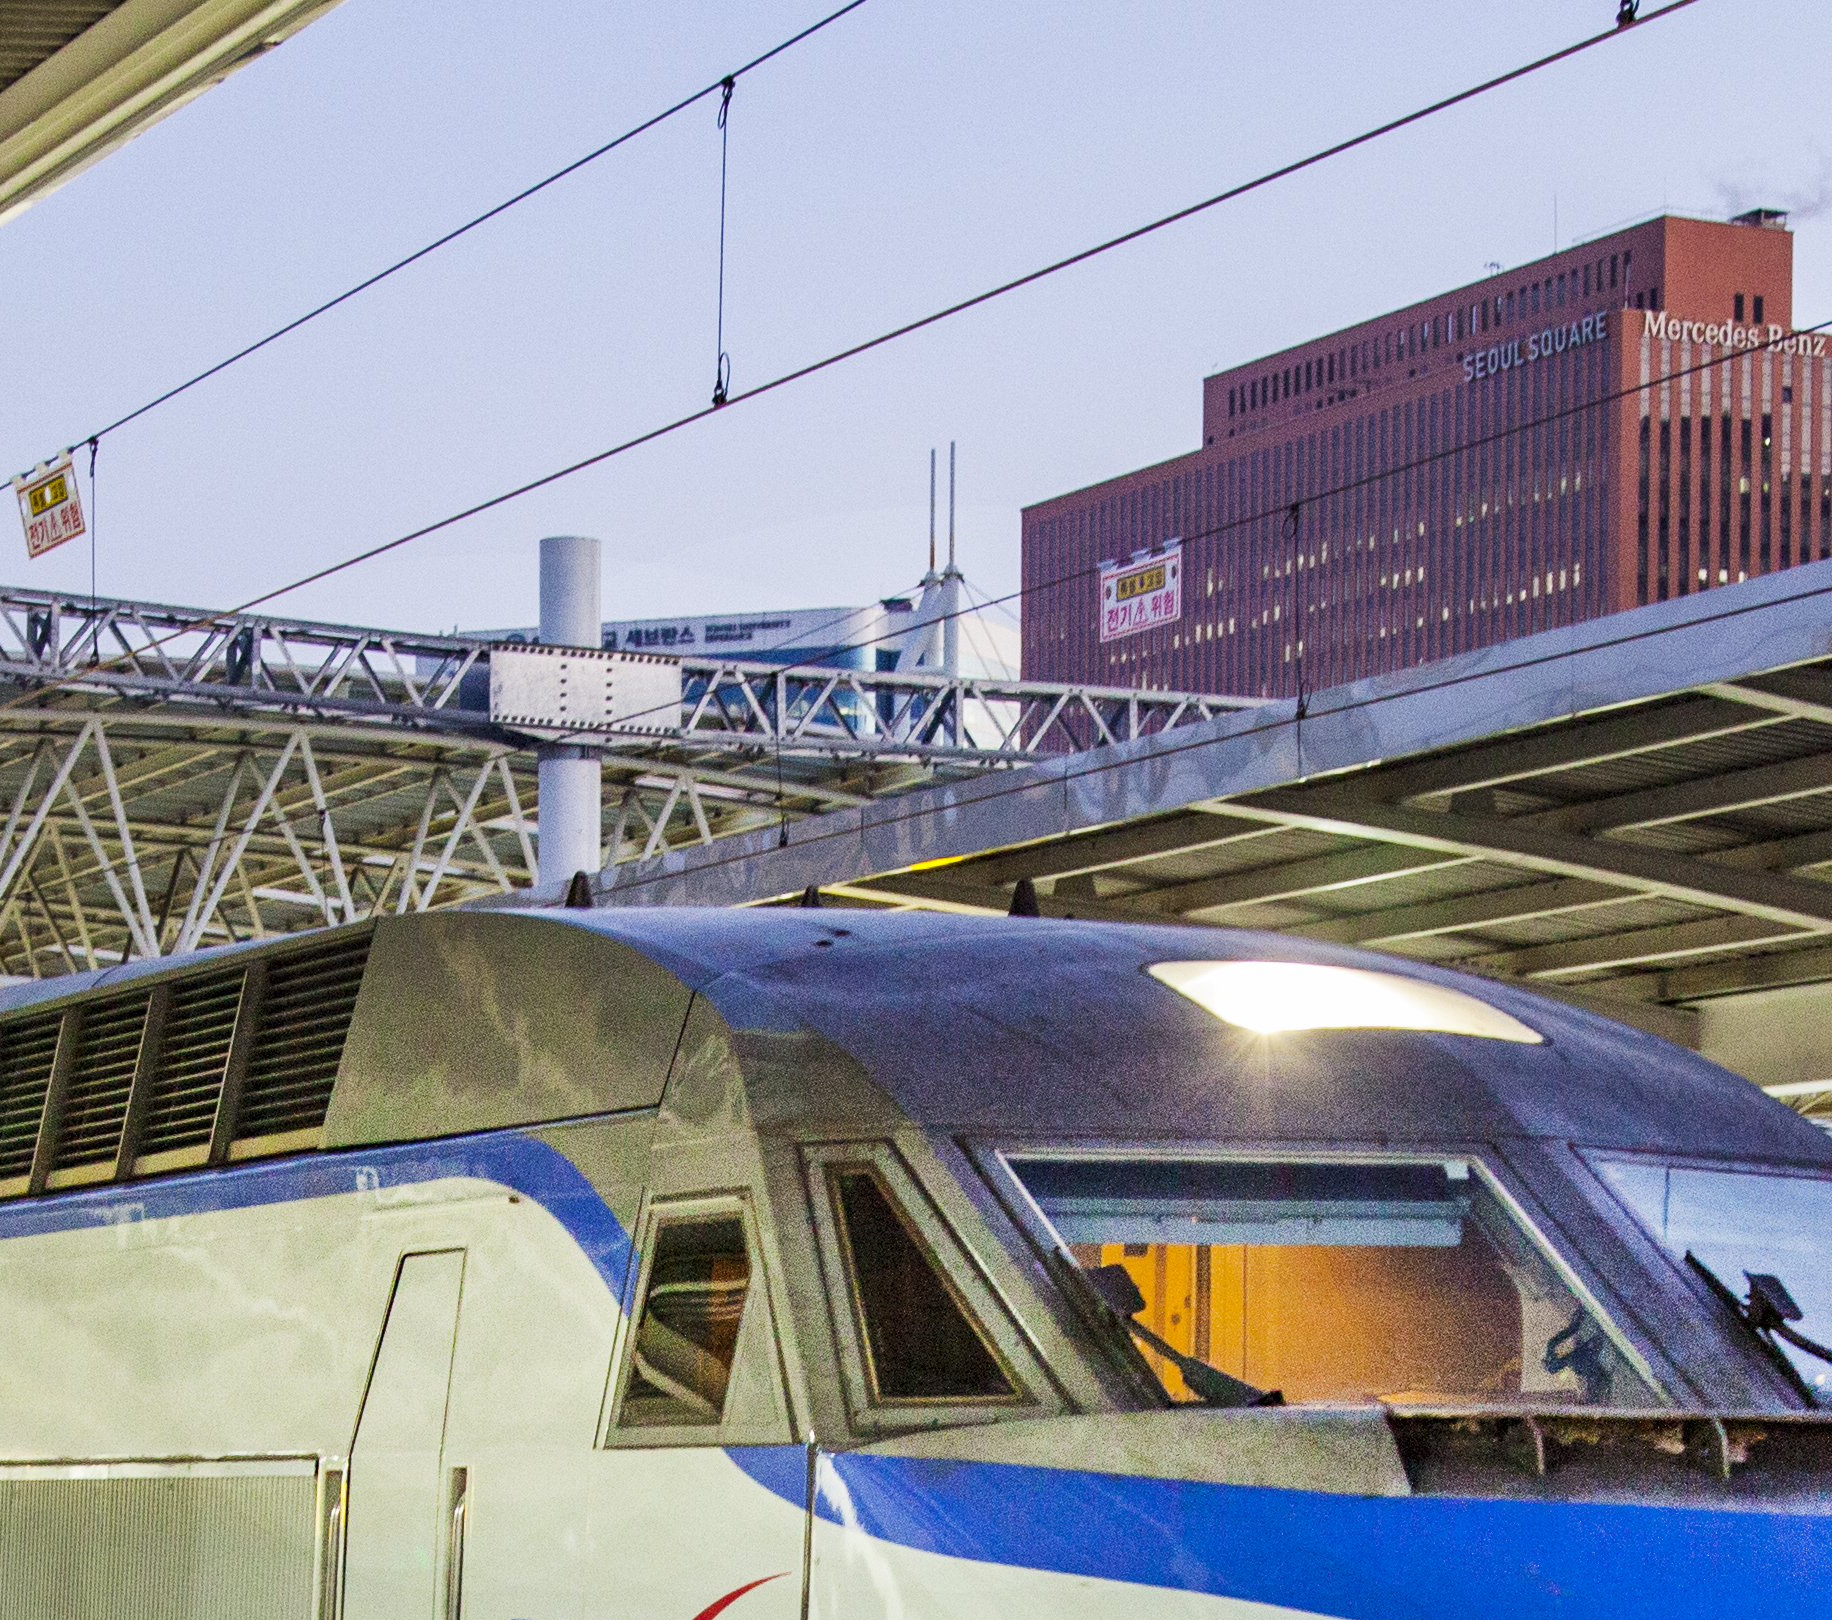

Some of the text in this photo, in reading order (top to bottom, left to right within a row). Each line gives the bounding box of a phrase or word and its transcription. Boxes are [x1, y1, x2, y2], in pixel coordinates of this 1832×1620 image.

[1462, 310, 1608, 382] SEOUL SQUARE
[1643, 310, 1759, 349] Mercedes
[1107, 590, 1175, 633] 전기 위험
[626, 626, 696, 648] 세브란스
